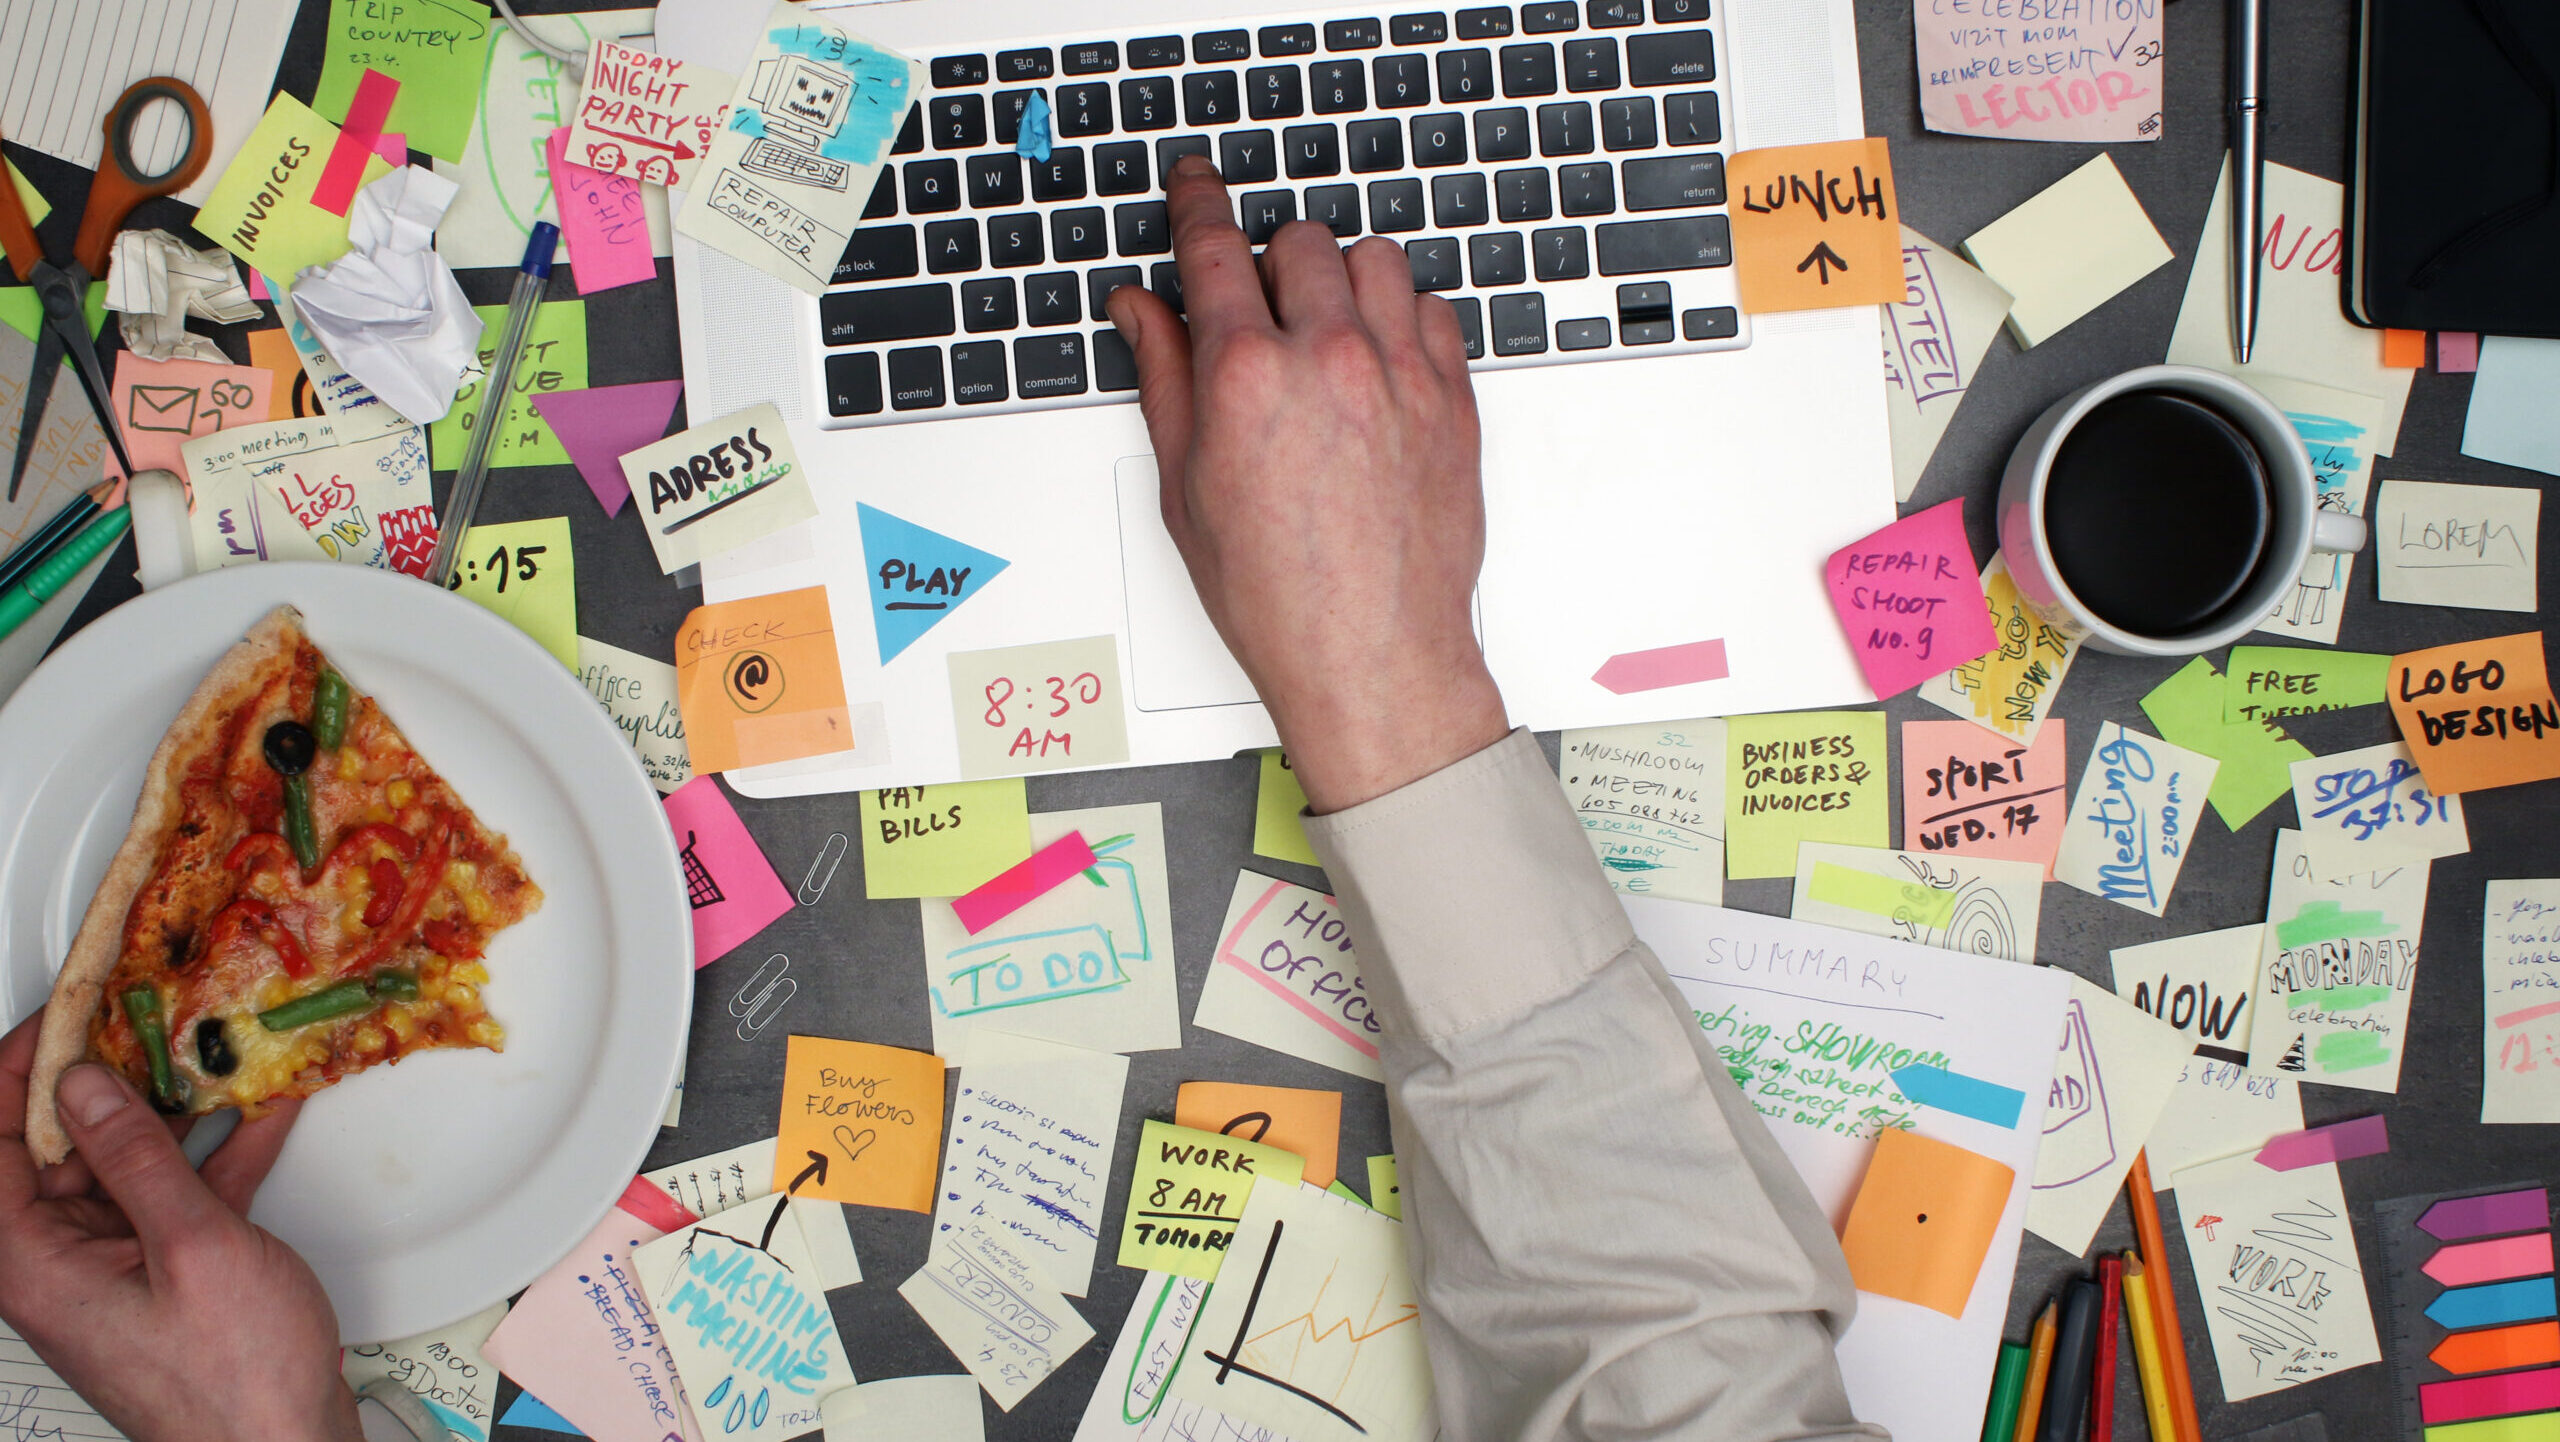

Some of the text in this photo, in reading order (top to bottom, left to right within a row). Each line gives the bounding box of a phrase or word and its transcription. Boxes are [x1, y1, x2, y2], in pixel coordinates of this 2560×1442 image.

[1563, 17, 1574, 25] F11
[1626, 12, 1639, 21] F12
[1432, 28, 1442, 37] F9
[1494, 22, 1508, 32] F10
[348, 26, 462, 55] COUNTRY
[1301, 40, 1310, 48] F7
[1367, 34, 1377, 43] F8
[1169, 52, 1179, 60] F5
[1235, 46, 1245, 55] F6
[2134, 40, 2164, 67] 32
[603, 43, 685, 78] TODAY
[1038, 64, 1048, 72] F3
[1103, 58, 1113, 66] F4
[1671, 62, 1705, 75] delete
[973, 70, 982, 79] F2
[599, 60, 690, 107] NIGHT
[1397, 82, 1407, 97] 9
[1461, 77, 1471, 93] 0
[1270, 93, 1280, 109] 7
[1334, 88, 1344, 104] 8
[1954, 70, 2151, 130] LECTOR
[1143, 105, 1153, 121] 5
[1207, 100, 1217, 115] 6
[580, 94, 691, 141] PARTY
[1079, 111, 1089, 126] 4
[953, 123, 963, 139] 2
[1432, 131, 1446, 147] O
[1496, 125, 1507, 142] P
[1241, 148, 1253, 164] Y
[1304, 142, 1318, 159] U
[1052, 165, 1062, 182] E
[1116, 160, 1127, 176] R
[1689, 162, 1713, 172] enter
[924, 178, 939, 194] Q
[985, 171, 1002, 188] W
[231, 136, 311, 252] INVOICES
[1455, 192, 1465, 208] L
[1683, 187, 1716, 199] return
[1742, 165, 1887, 222] LUNCH
[721, 177, 816, 244] REPAIR
[1329, 203, 1337, 219] J
[1390, 197, 1402, 213] K
[1262, 207, 1276, 224] H
[712, 195, 812, 264] COMPUTER
[1072, 226, 1085, 242] D
[1137, 219, 1147, 236] F
[946, 237, 959, 254] A
[1010, 231, 1021, 248] S
[1697, 246, 1721, 259] shift
[853, 259, 876, 272] lock
[983, 296, 995, 312] Z
[1046, 290, 1059, 306] X
[1525, 300, 1537, 310] alt
[831, 323, 854, 336] shift
[1506, 335, 1541, 348] option
[957, 351, 969, 360] alt
[960, 383, 994, 396] option
[1024, 373, 1077, 389] command
[838, 394, 849, 406] fn
[897, 386, 933, 401] control
[240, 431, 309, 455] meeting
[648, 426, 773, 515] ADRESS
[2399, 511, 2528, 567] LOREM
[1845, 550, 1959, 581] REPAIR
[879, 558, 971, 597] PLAY
[1851, 586, 1947, 620] SHOOT
[686, 620, 788, 651] CHECK
[2246, 670, 2321, 695] FREE
[2399, 658, 2505, 703] LOGO
[984, 671, 1102, 728] 8:30
[2415, 698, 2560, 746] DESIGN
[1008, 728, 1071, 758] AM
[1579, 742, 1705, 776] MUSHROOM
[1742, 735, 1855, 770] BUSINESS
[1745, 763, 1839, 789] ORDERS
[1925, 748, 2028, 801] SPORT
[1590, 774, 1698, 803] MEETING
[878, 784, 925, 811] PAY
[1581, 794, 1623, 810] 605
[1741, 791, 1851, 816] INVOICES
[2087, 724, 2156, 900] Meeting
[879, 804, 962, 845] BILLS
[1918, 802, 2041, 851] WED. 17
[1704, 936, 1908, 997] SUMMARY
[2269, 937, 2420, 995] MONDAY
[946, 950, 1104, 1007] TO DO
[2134, 972, 2248, 1042] NOW
[2287, 1007, 2394, 1037] celebration
[819, 1067, 892, 1099] Buy
[804, 1093, 915, 1126] Flowers
[1160, 1140, 1255, 1175] WORK
[1149, 1178, 1227, 1215] 8 AM
[2228, 1243, 2332, 1311] WORK
[688, 1247, 834, 1368] WASHING
[940, 1256, 1052, 1344] CONCERT
[666, 1279, 828, 1396] MACHINE
[407, 1361, 490, 1420] Doctor
